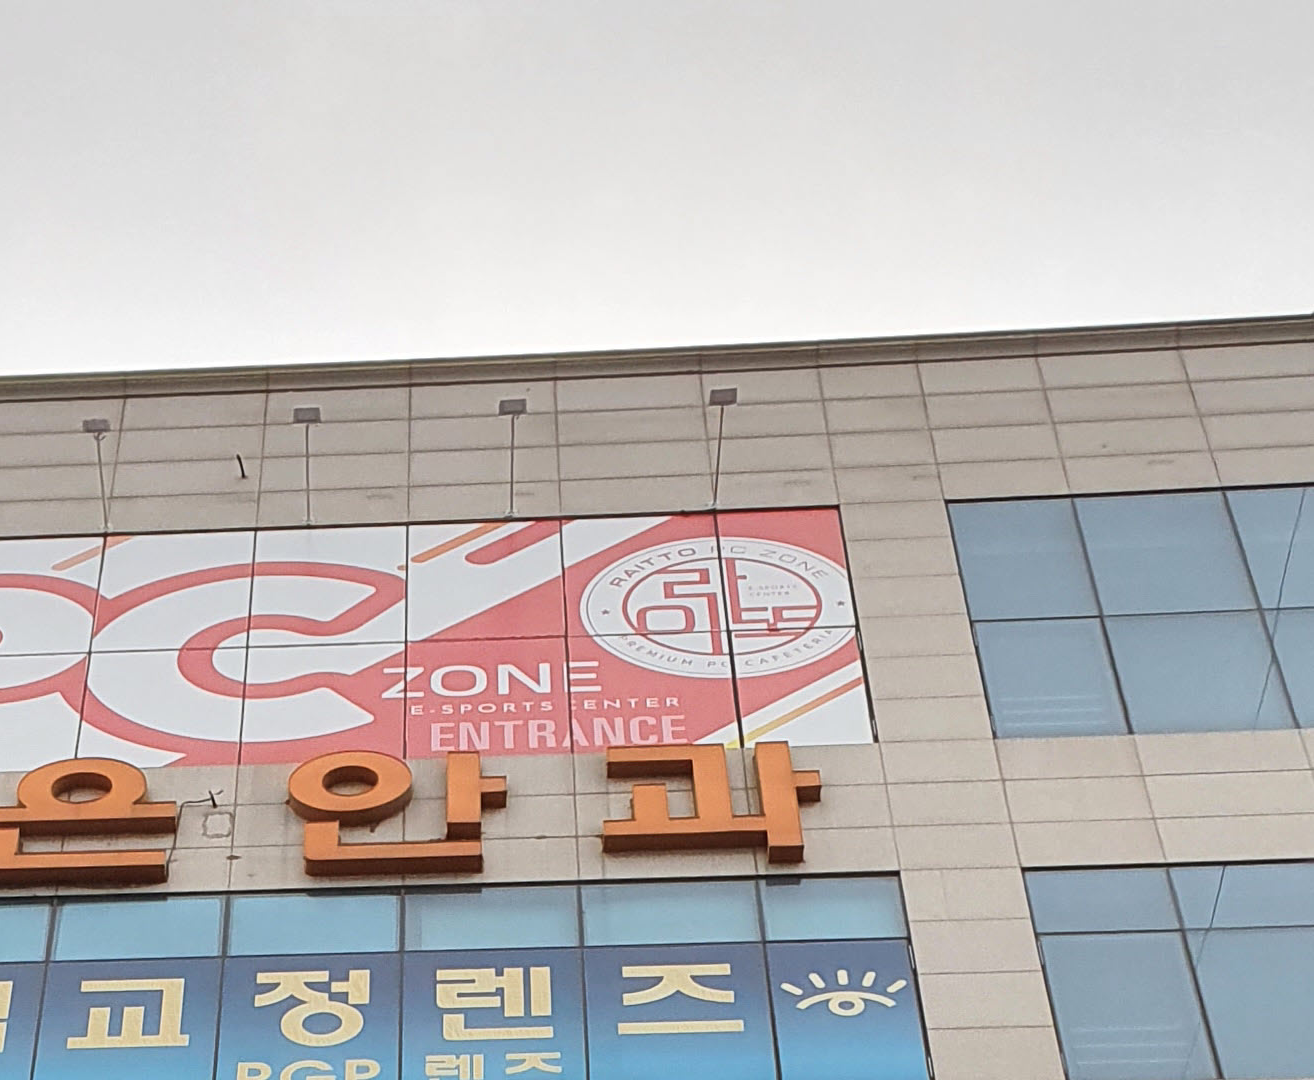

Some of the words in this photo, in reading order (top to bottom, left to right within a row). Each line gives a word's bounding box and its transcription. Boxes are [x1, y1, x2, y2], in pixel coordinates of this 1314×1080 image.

[609, 547, 697, 589] RAITTO
[759, 546, 828, 580] ZONE
[620, 635, 693, 667] PREMIUM
[744, 629, 834, 667] CAFETERIA
[381, 660, 603, 699] ZONE
[410, 700, 554, 716] E-SPORTS
[430, 714, 687, 751] ENTRANCE
